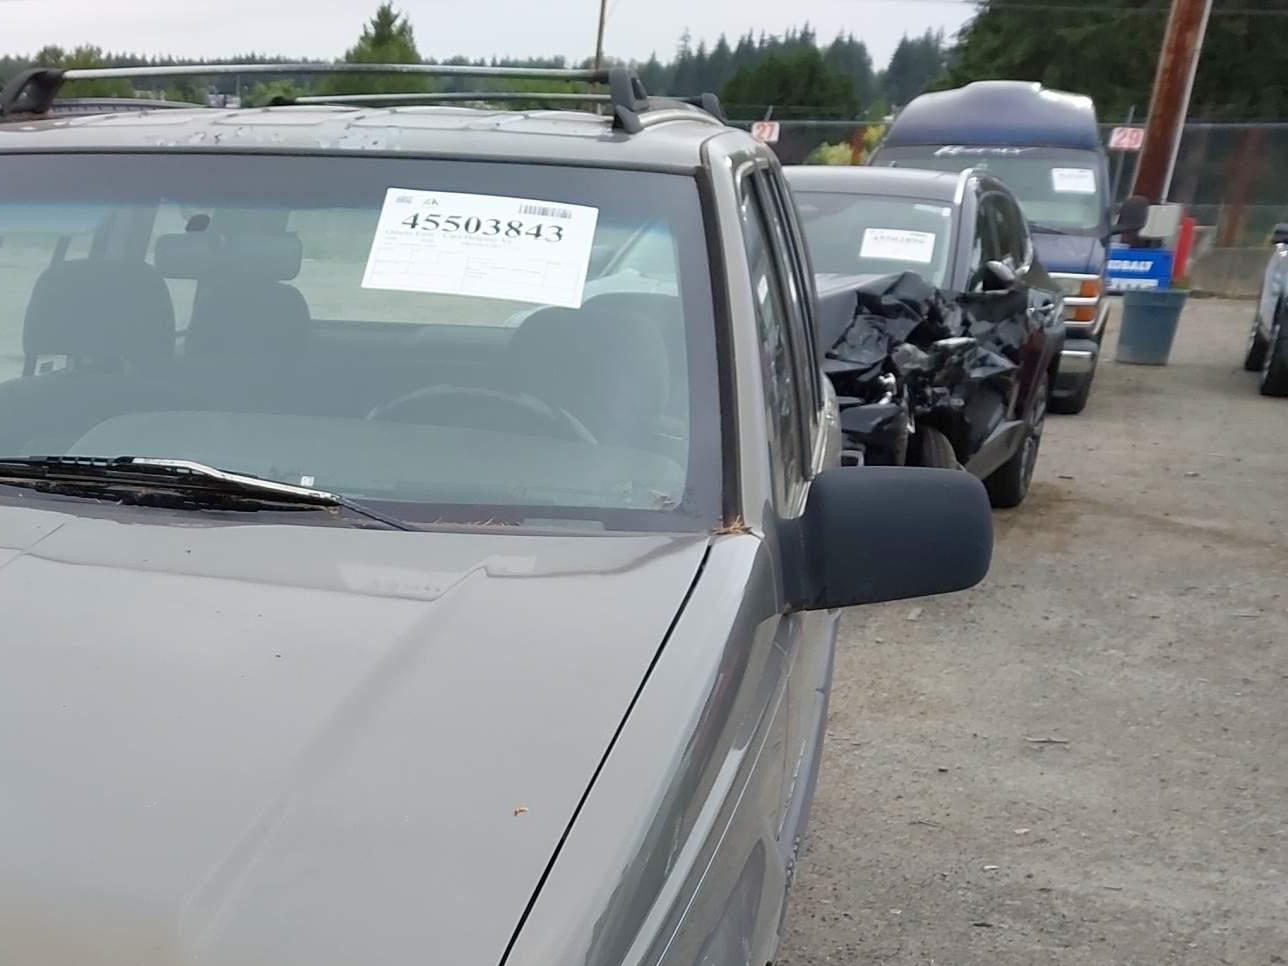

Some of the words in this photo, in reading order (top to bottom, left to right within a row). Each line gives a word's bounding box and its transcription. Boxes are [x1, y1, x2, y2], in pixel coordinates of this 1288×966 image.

[756, 123, 776, 140] 27
[1114, 128, 1141, 146] 29
[400, 212, 565, 243] 45503843
